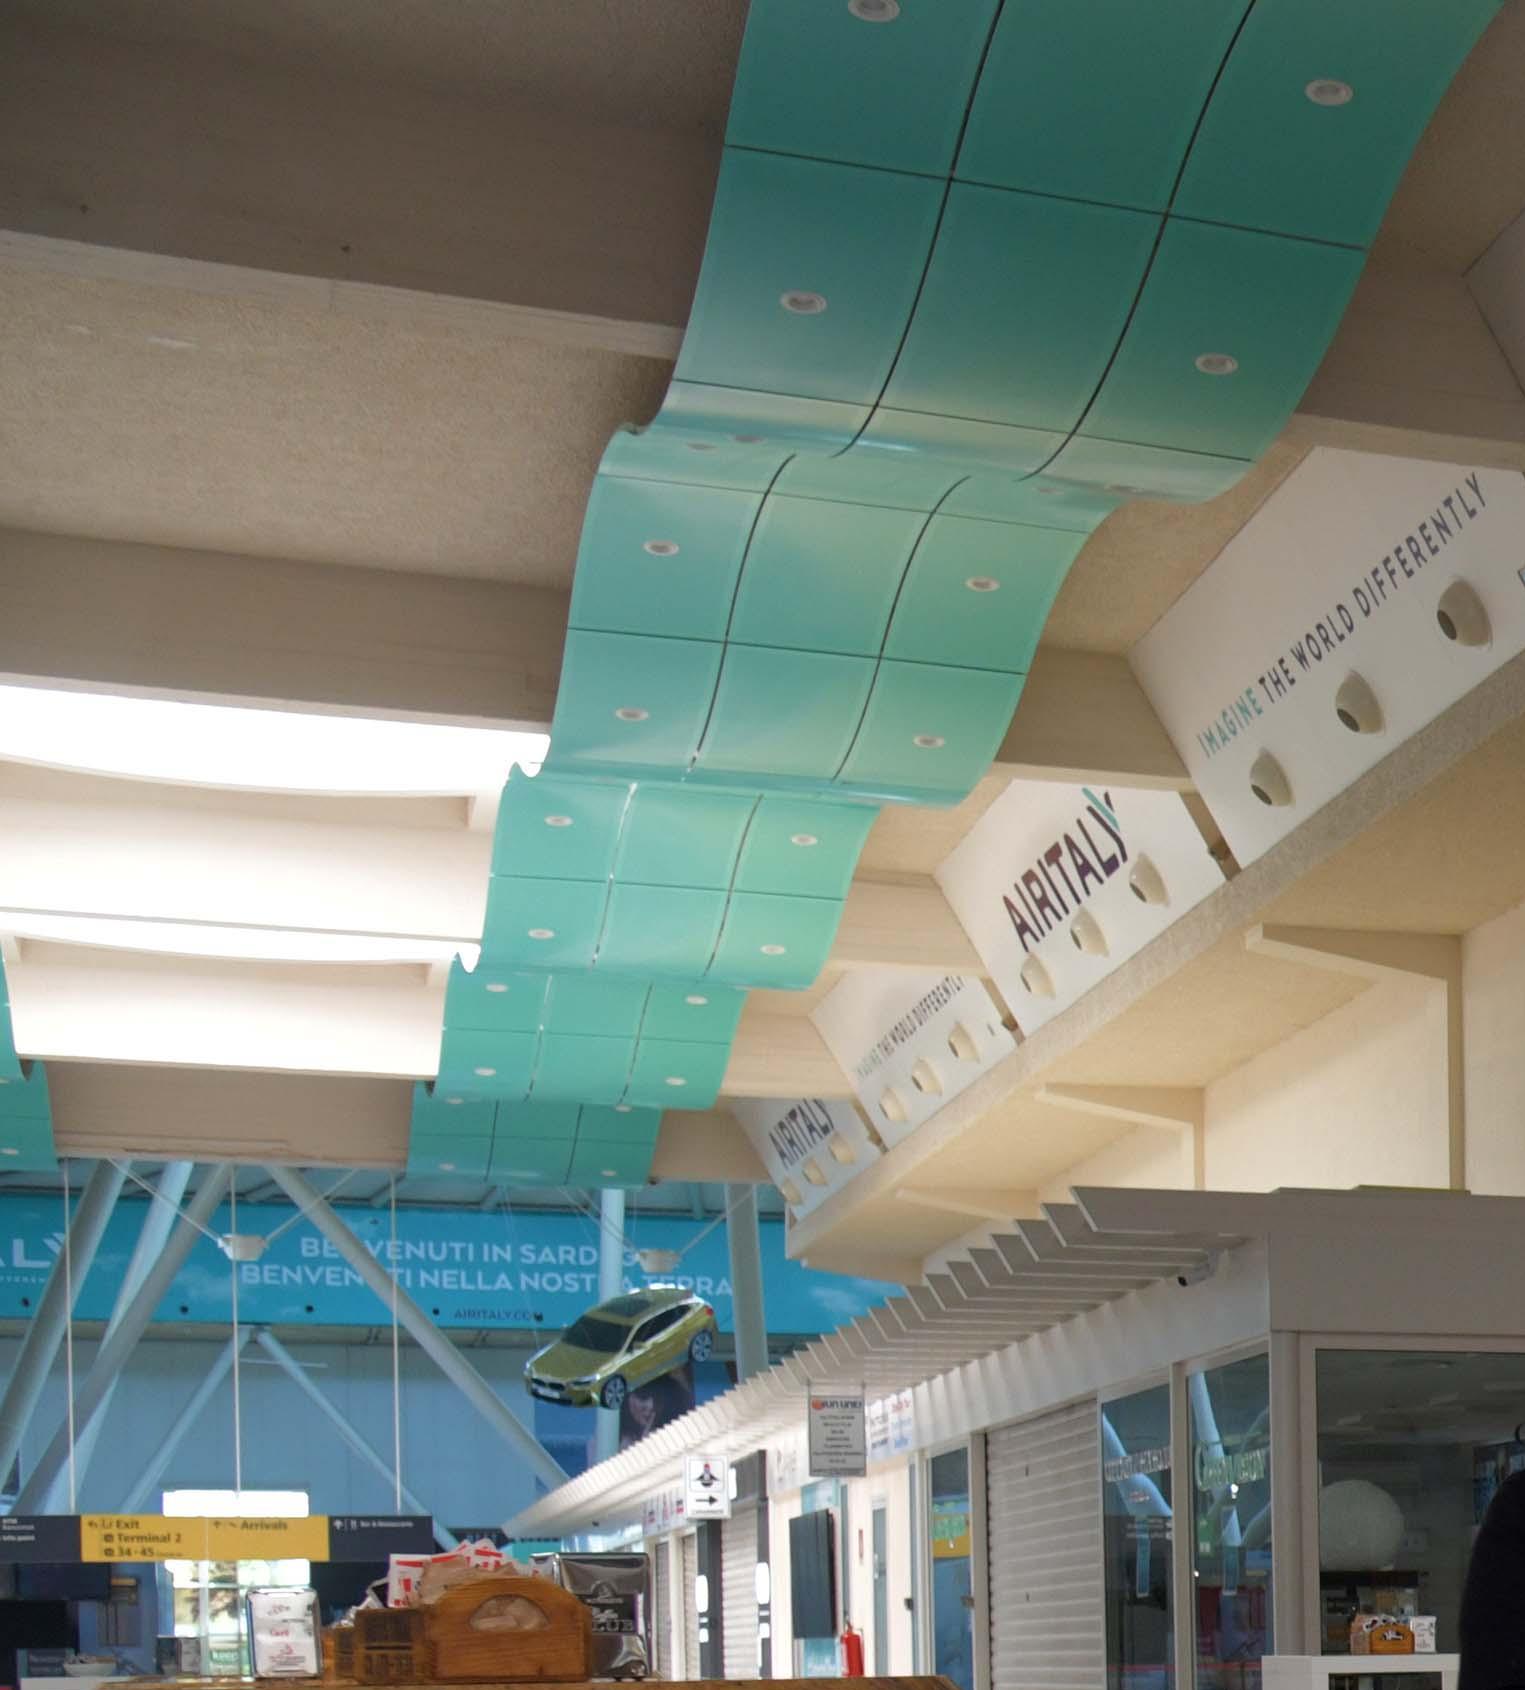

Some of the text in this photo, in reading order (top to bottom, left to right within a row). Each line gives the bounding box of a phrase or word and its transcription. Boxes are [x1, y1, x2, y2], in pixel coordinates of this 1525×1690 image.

[1196, 472, 1487, 758] IMAGINE THE WORLD DIFFERENTLY
[1002, 787, 1128, 952] AIRITALY
[300, 1237, 474, 1262] BEVENUTI
[482, 1243, 512, 1263] IN
[241, 1264, 412, 1289] BENVENTI
[420, 1269, 514, 1291] NELLA
[116, 1520, 139, 1529] Exit
[240, 1519, 288, 1531] Arrivals
[118, 1533, 182, 1543] Terminal 2
